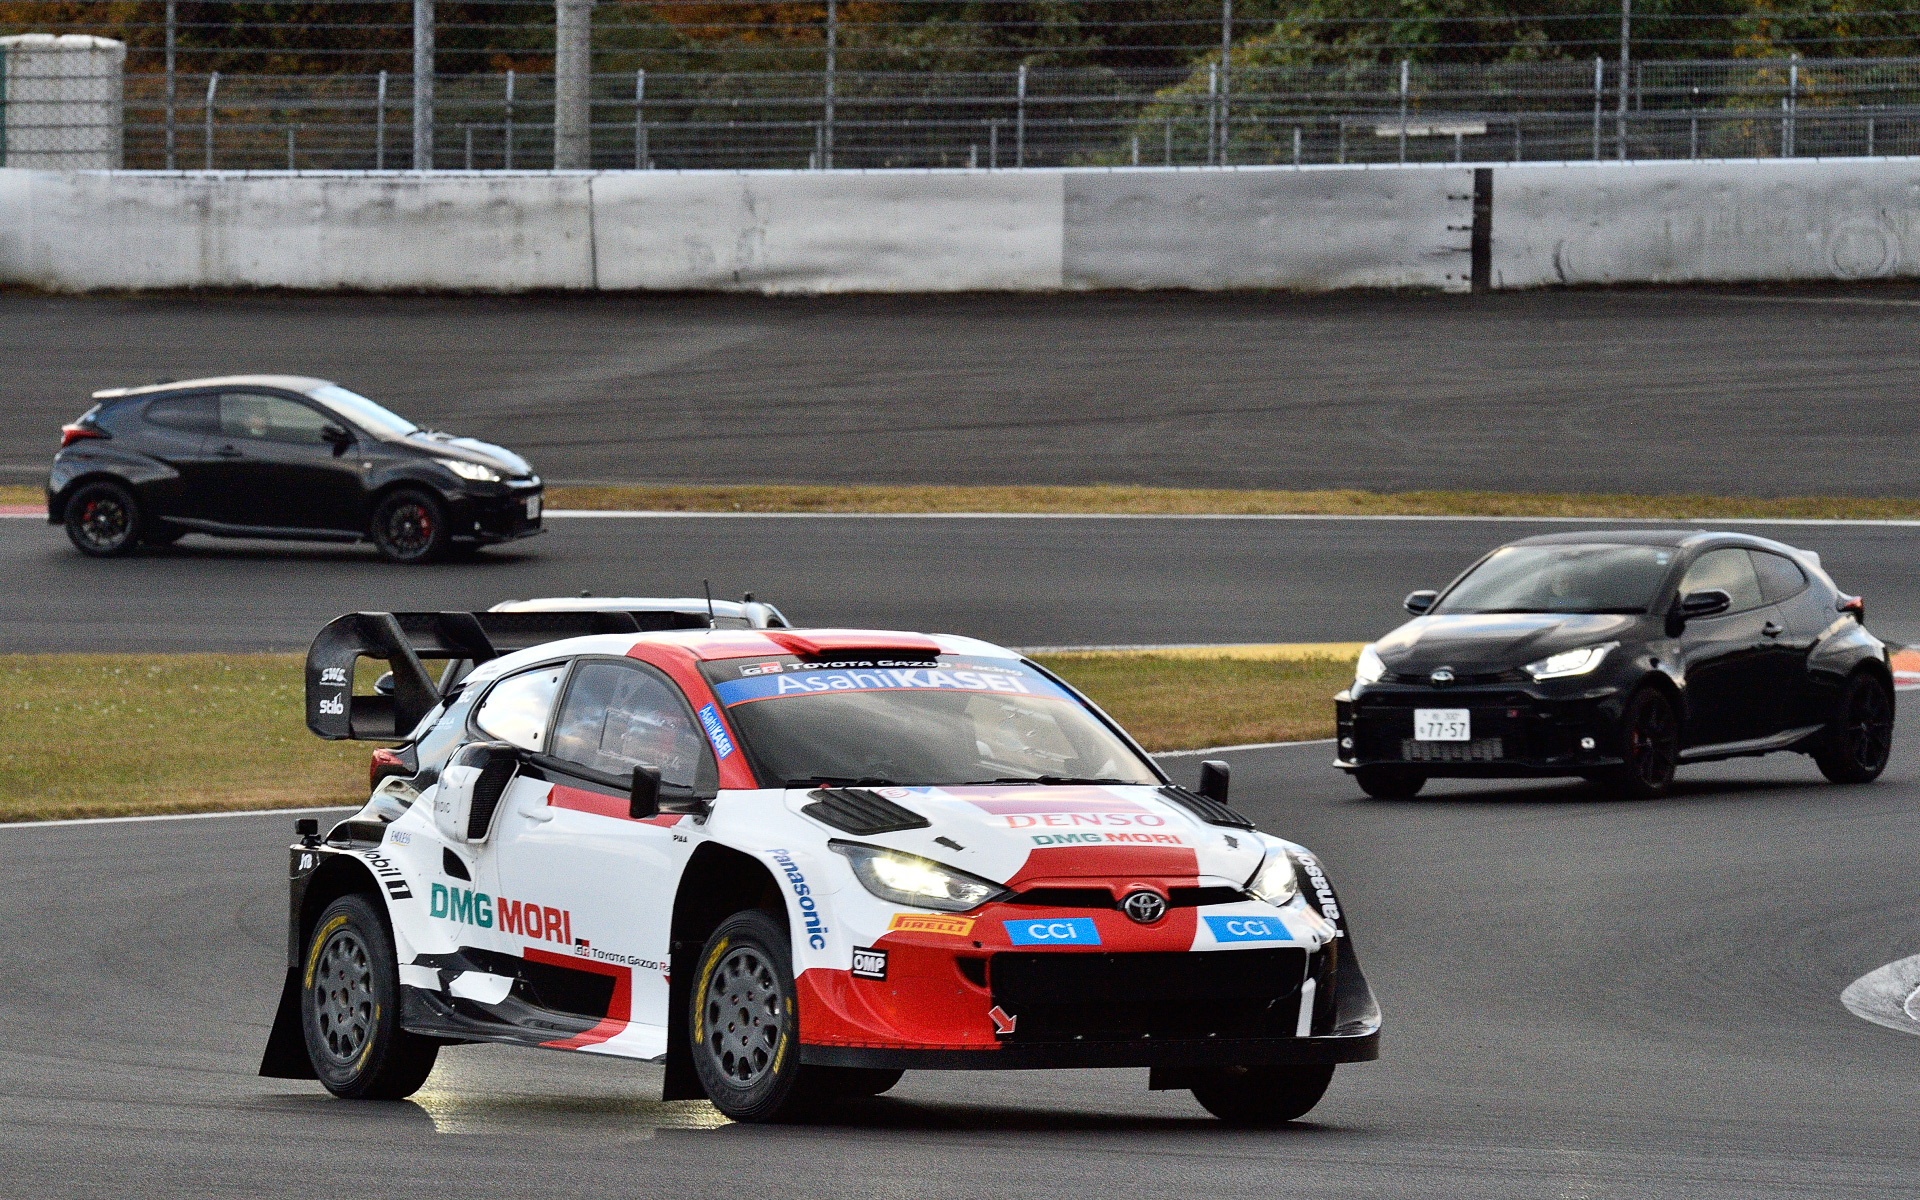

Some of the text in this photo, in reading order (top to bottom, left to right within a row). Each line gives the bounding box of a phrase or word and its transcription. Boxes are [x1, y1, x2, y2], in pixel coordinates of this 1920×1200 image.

[787, 661, 874, 670] TOYOTA
[319, 692, 344, 715] Stilo
[1427, 722, 1467, 738] 77-57
[1005, 813, 1165, 829] DENSO
[1031, 832, 1182, 845] DMG MORI
[361, 850, 402, 877] obil
[764, 848, 830, 951] Panasonic
[430, 882, 572, 946] DMG MORI
[893, 915, 970, 934] PIRELLI
[592, 948, 626, 964] TOYOTA
[627, 955, 658, 970] GAZOO
[853, 953, 886, 973] OMP
